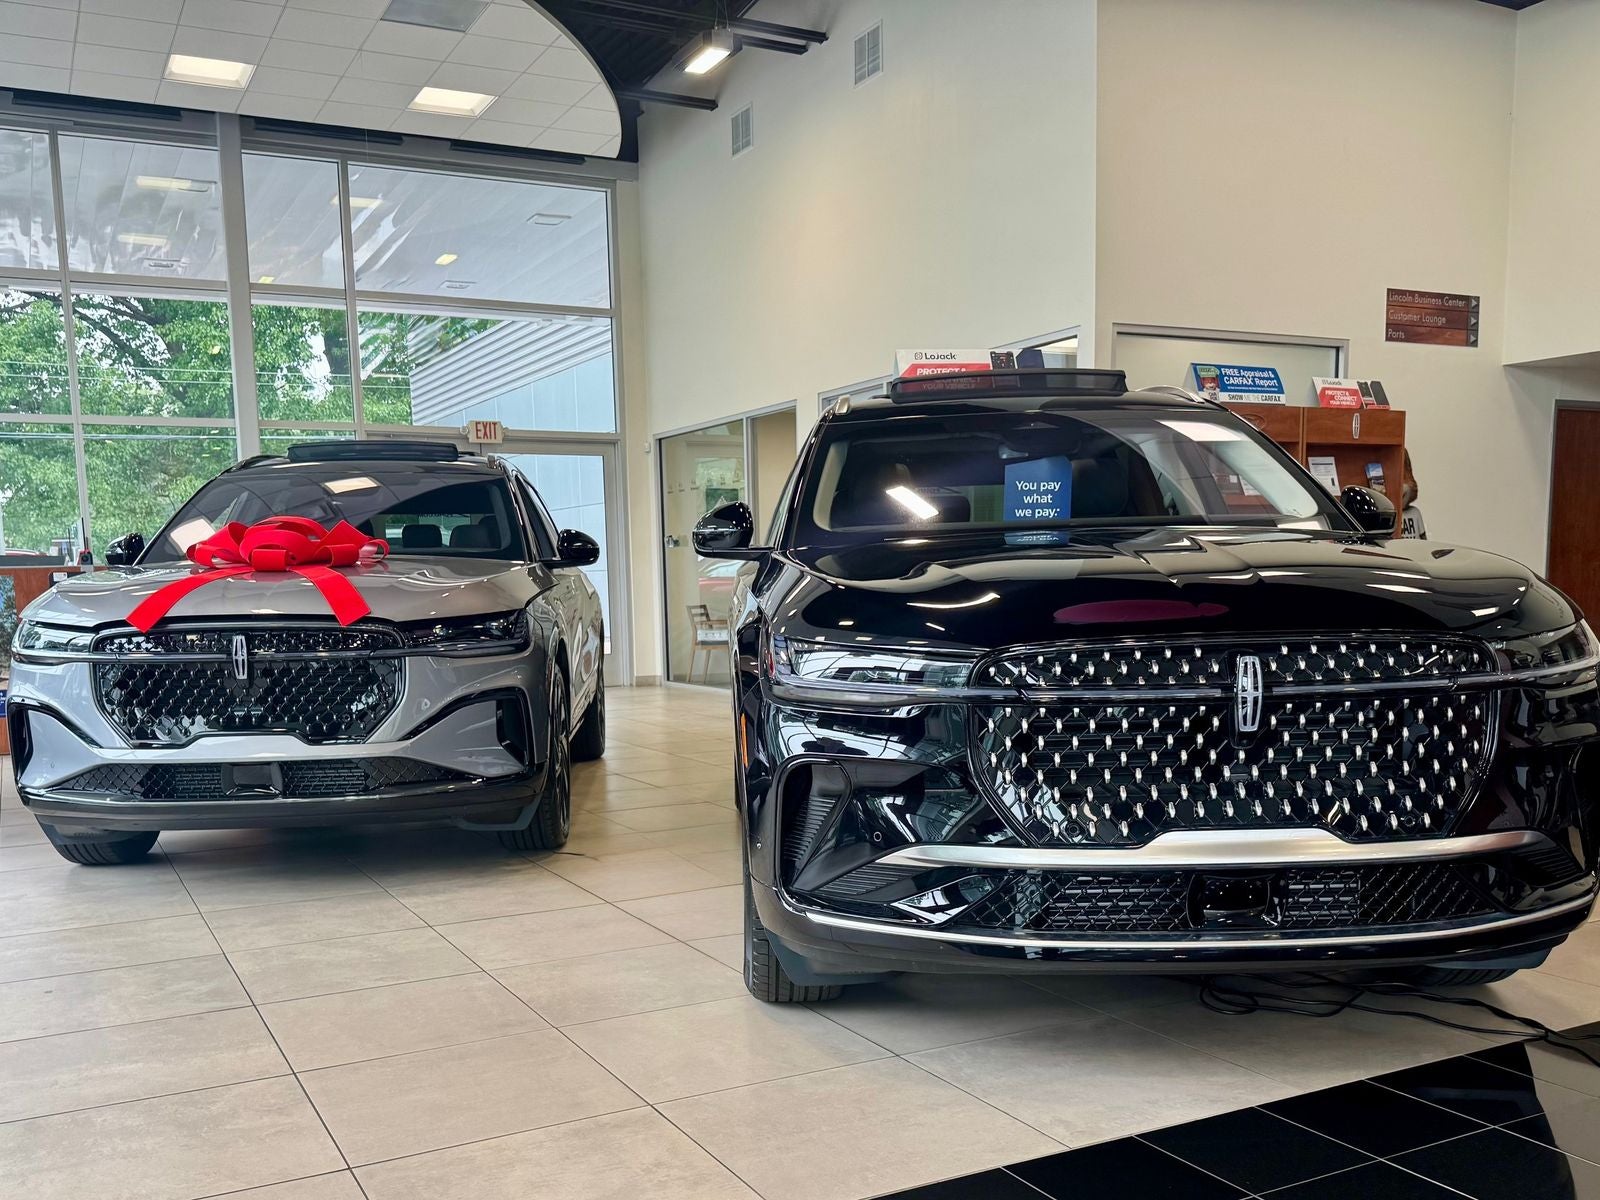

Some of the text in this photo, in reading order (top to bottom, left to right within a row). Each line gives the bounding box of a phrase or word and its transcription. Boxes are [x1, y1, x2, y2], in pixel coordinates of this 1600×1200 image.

[1389, 291, 1466, 307] Lincoln Business Center
[1388, 310, 1447, 325] Customer Lounge
[1221, 368, 1240, 376] FREE
[1240, 370, 1269, 379] Appraisal
[1224, 377, 1278, 387] CARFAX Report
[475, 421, 497, 440] EXIT
[1016, 481, 1061, 492] You pay
[1023, 493, 1052, 504] what
[1015, 508, 1032, 517] we
